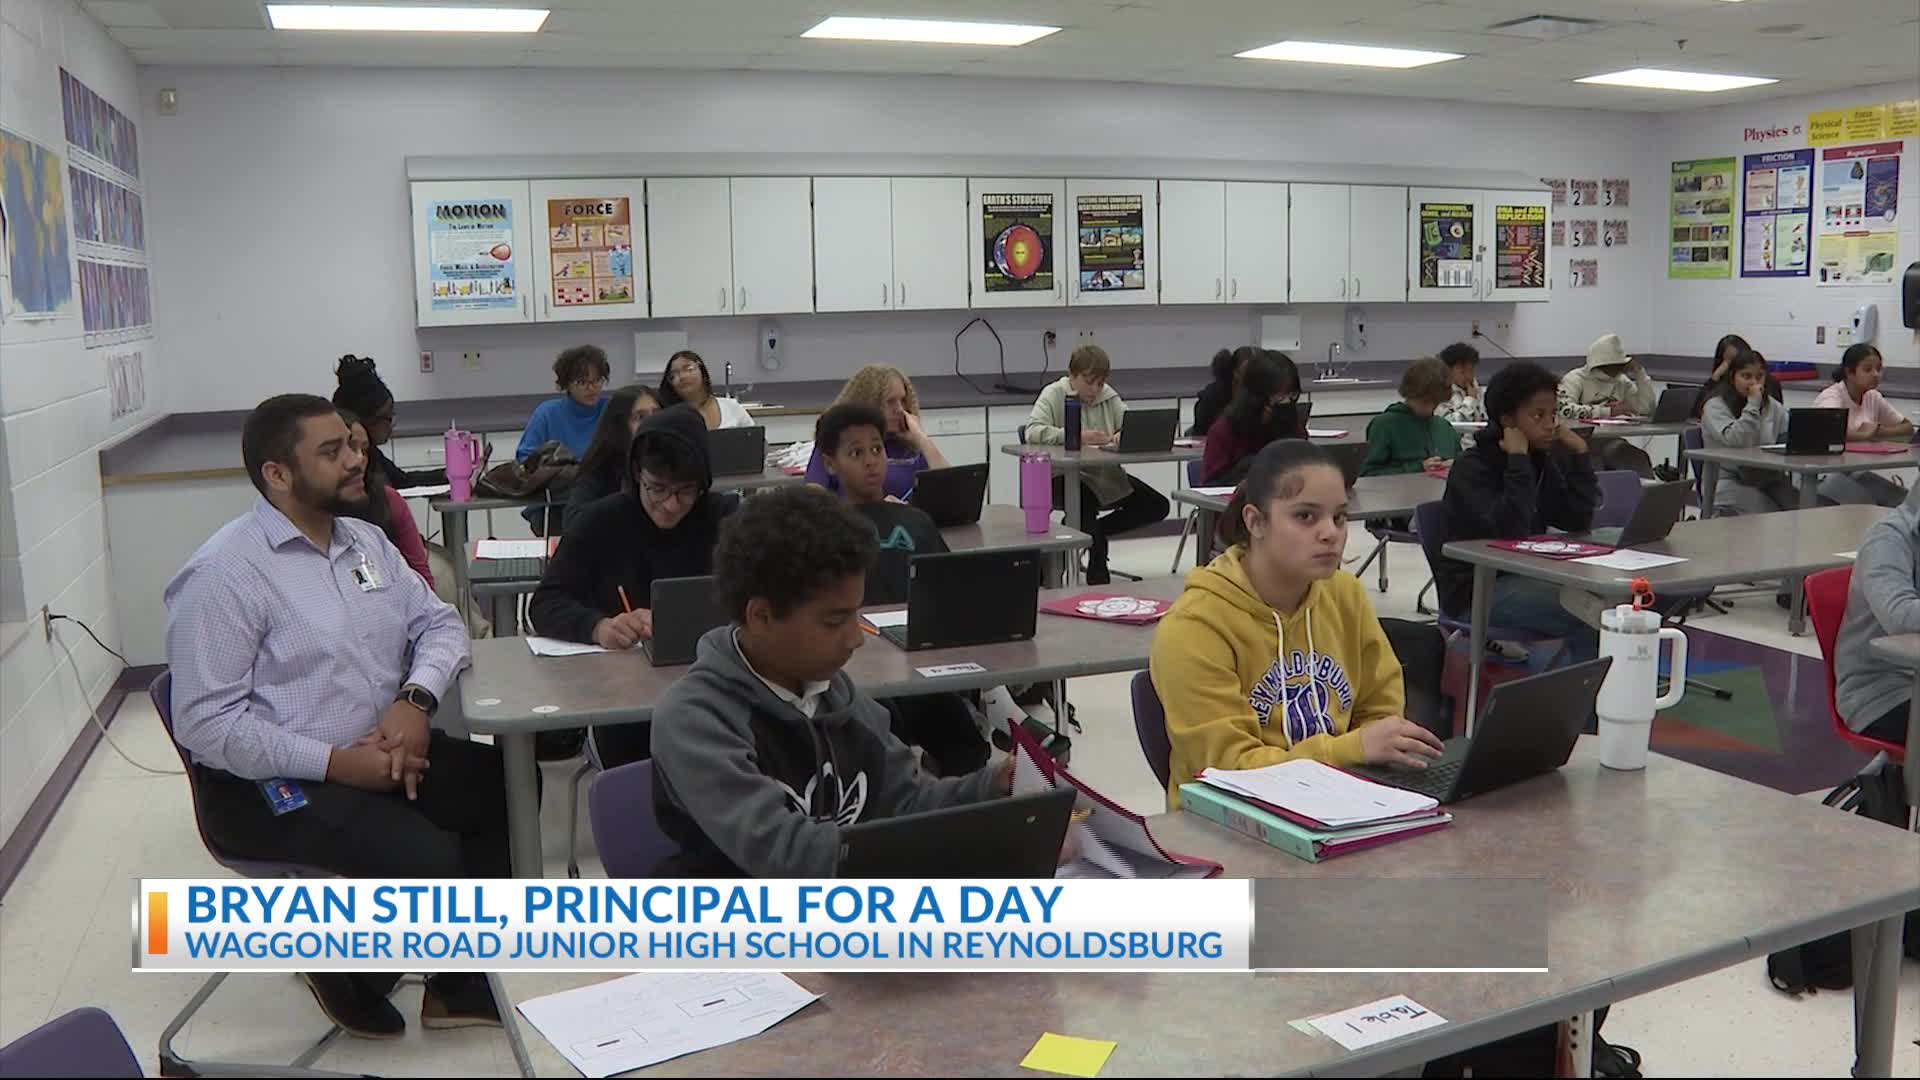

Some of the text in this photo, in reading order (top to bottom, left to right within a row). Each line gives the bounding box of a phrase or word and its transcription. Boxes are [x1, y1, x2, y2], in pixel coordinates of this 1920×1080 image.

[1810, 119, 1842, 129] Physical
[1744, 123, 1789, 142] Physics
[1761, 153, 1795, 163] FRICTION
[1572, 190, 1581, 206] 2
[1605, 190, 1612, 206] 3
[436, 204, 506, 219] MOTION
[564, 203, 613, 216] FORCE
[1573, 231, 1581, 247] 5
[1603, 231, 1613, 247] 6
[1573, 271, 1579, 287] 7
[1361, 1004, 1427, 1024] Table
